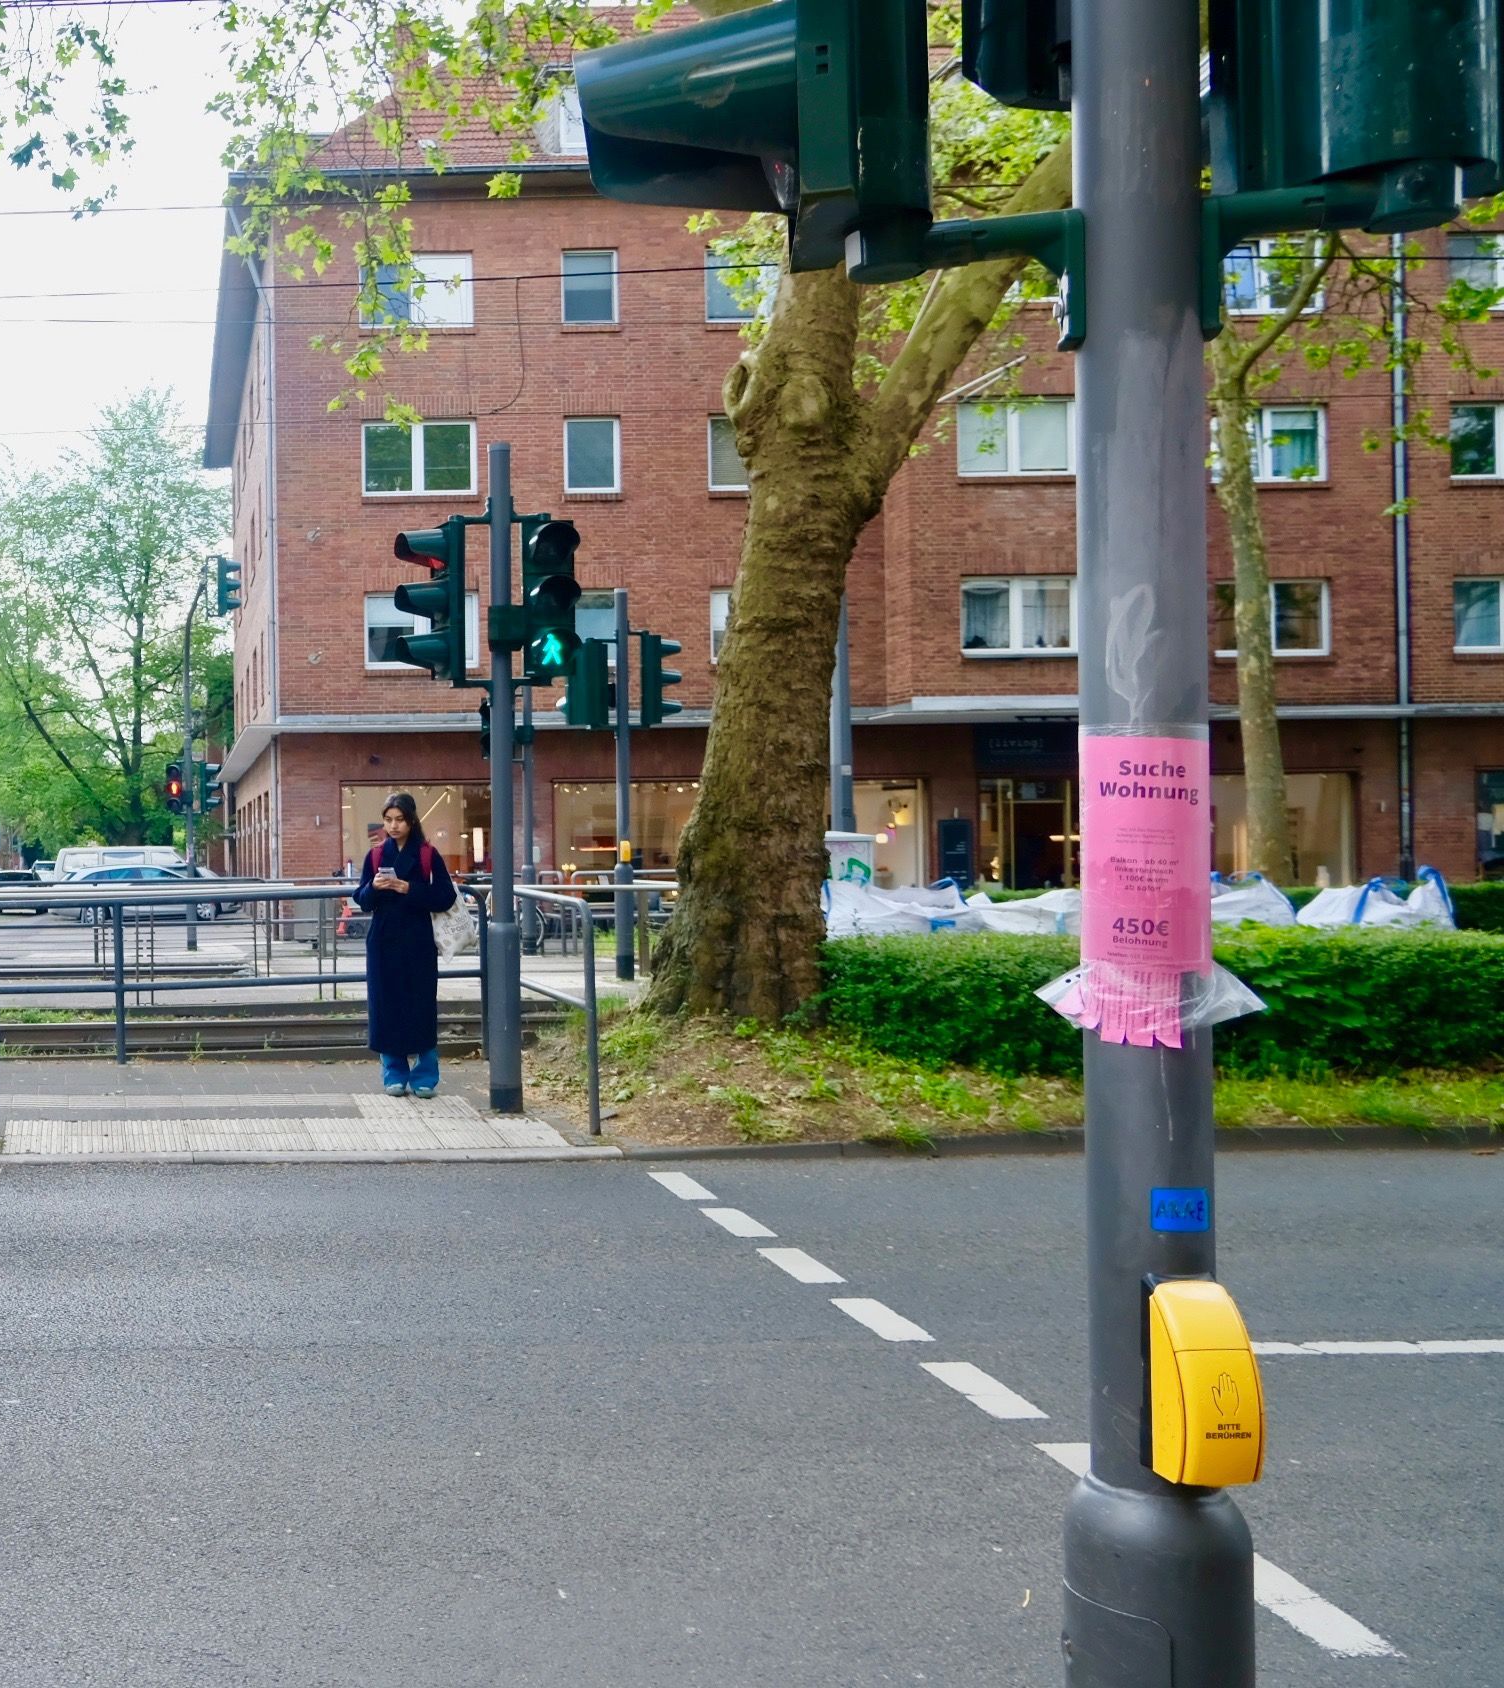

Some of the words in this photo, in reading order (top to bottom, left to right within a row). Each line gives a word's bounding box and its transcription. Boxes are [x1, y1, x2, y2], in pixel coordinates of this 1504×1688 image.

[1119, 760, 1186, 778] Suche
[1099, 781, 1199, 805] Wohnung
[1110, 856, 1138, 864] Balkon
[1145, 857, 1156, 865] ab
[1112, 917, 1170, 936] 450€
[1112, 935, 1169, 949] Belohnung
[1217, 1423, 1241, 1431] BITTE
[1205, 1431, 1252, 1440] BERÜHREN
